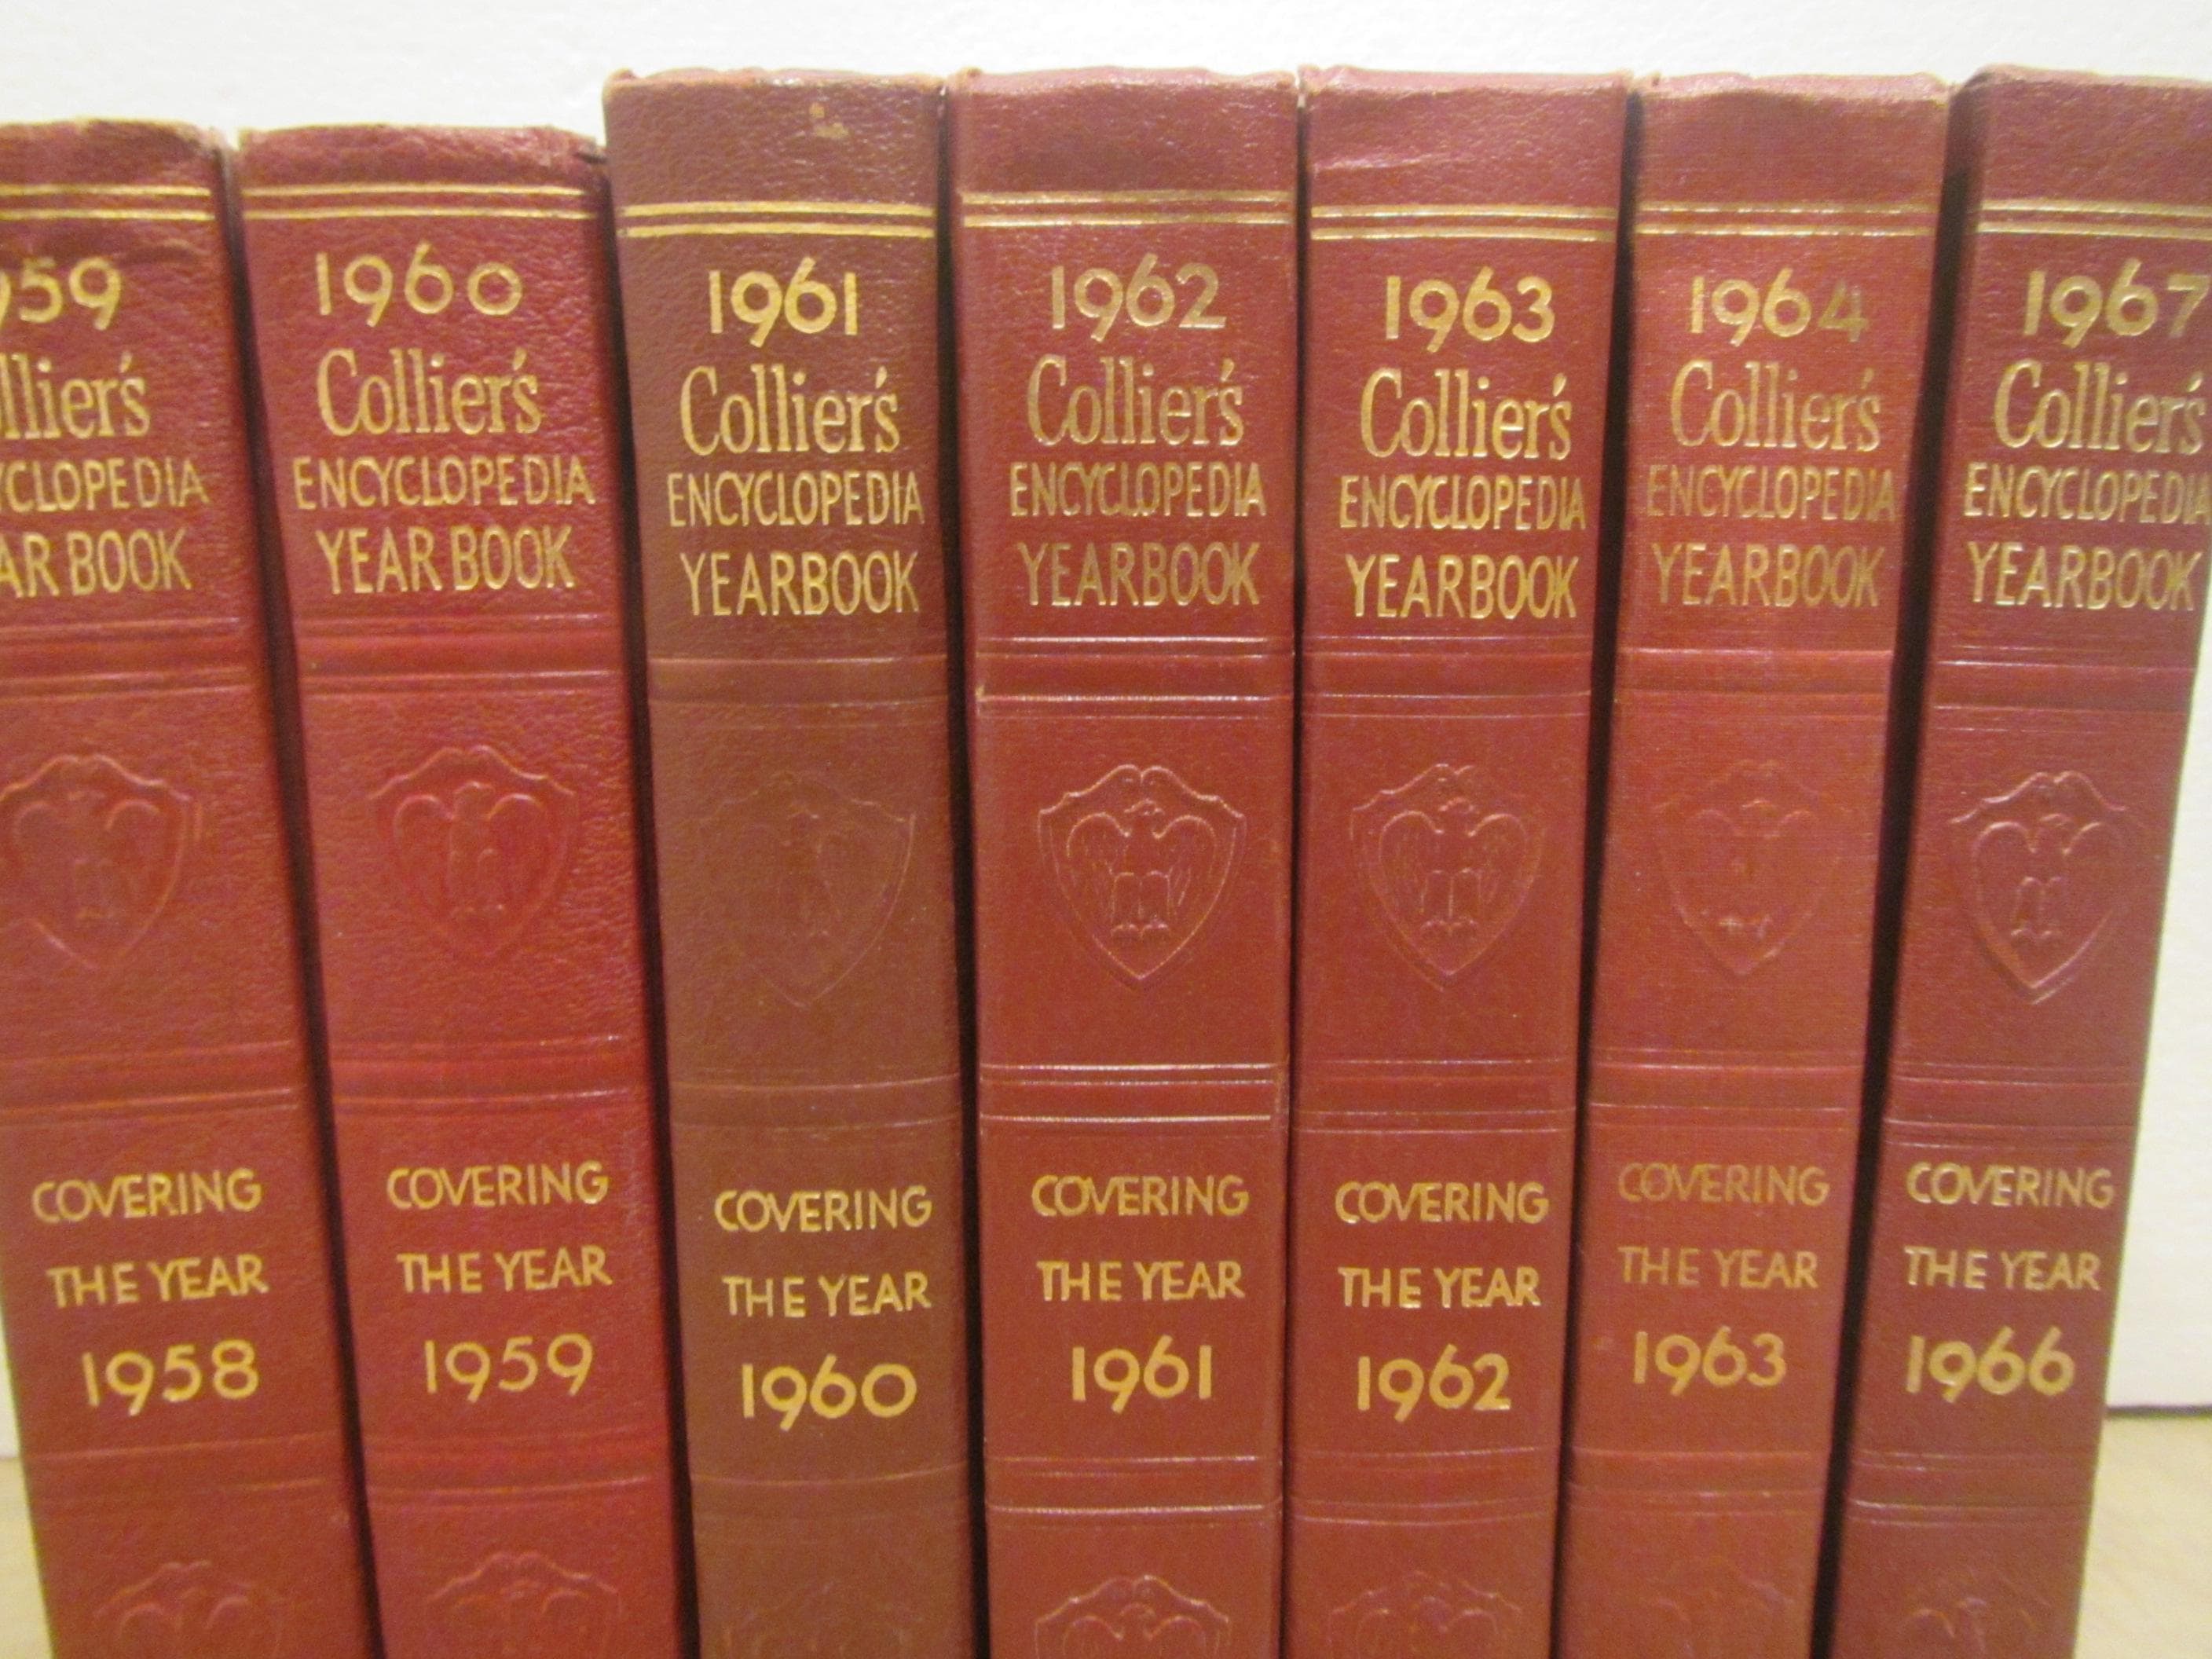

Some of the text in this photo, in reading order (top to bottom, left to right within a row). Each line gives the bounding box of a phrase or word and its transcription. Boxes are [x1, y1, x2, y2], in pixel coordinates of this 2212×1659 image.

[0, 255, 121, 331] 59
[315, 241, 522, 327] 1960
[709, 256, 858, 348] 1961
[1050, 252, 1228, 342] 1962
[1385, 266, 1555, 353] 1963
[1689, 267, 1869, 347] 1964
[2023, 258, 2210, 348] 1967
[318, 348, 544, 437] Collier's
[679, 364, 900, 456] Collier's
[1027, 354, 1244, 447] Collier's
[1361, 366, 1572, 460] Collier's
[1671, 358, 1881, 452] Collier's
[1994, 359, 2205, 456] Collier's
[0, 456, 210, 514] CLOPEDIA
[293, 455, 596, 510] ENCYCLOPEDIA
[668, 471, 925, 527] ENCYCLOPEDIA
[1010, 461, 1267, 518] ENCYCLOPEDIA
[1339, 474, 1587, 530] ENCYCLOPEDIA
[1648, 464, 1897, 522] ENCYCLOPEDIA
[1964, 462, 2212, 526] ENCYCLOPEDIA
[67, 527, 192, 596] BOOK
[315, 524, 575, 595] YEAR BOOK
[680, 550, 920, 617] YEARBOOK
[1017, 542, 1259, 607] YEARBOOK
[1346, 554, 1579, 620] YEARBOOK
[1652, 543, 1885, 608] YEARBOOK
[1968, 541, 2201, 611] YEARBOOK
[32, 1168, 262, 1225] COVERING
[387, 1160, 610, 1210] COVERING
[714, 1185, 933, 1232] COVERING
[1031, 1174, 1250, 1218] COVERING
[1335, 1180, 1550, 1225] COVERING
[1617, 1162, 1829, 1208] COVERING
[1906, 1161, 2115, 1209] COVERING
[47, 1254, 269, 1309] THE YEAR
[397, 1246, 613, 1294] THE YEAR
[723, 1271, 932, 1318] THE YEAR
[1037, 1260, 1245, 1302] THE YEAR
[1339, 1266, 1541, 1309] THE YEAR
[1619, 1245, 1818, 1290] THE YEAR
[1906, 1245, 2102, 1293] THE YEAR
[81, 1339, 259, 1415] 1958
[423, 1332, 595, 1404] 1959
[742, 1353, 917, 1431] 1960
[1072, 1334, 1213, 1413] 1961
[1357, 1344, 1511, 1423] 1962
[1633, 1324, 1787, 1396] 1963
[1906, 1324, 2075, 1403] 1966
